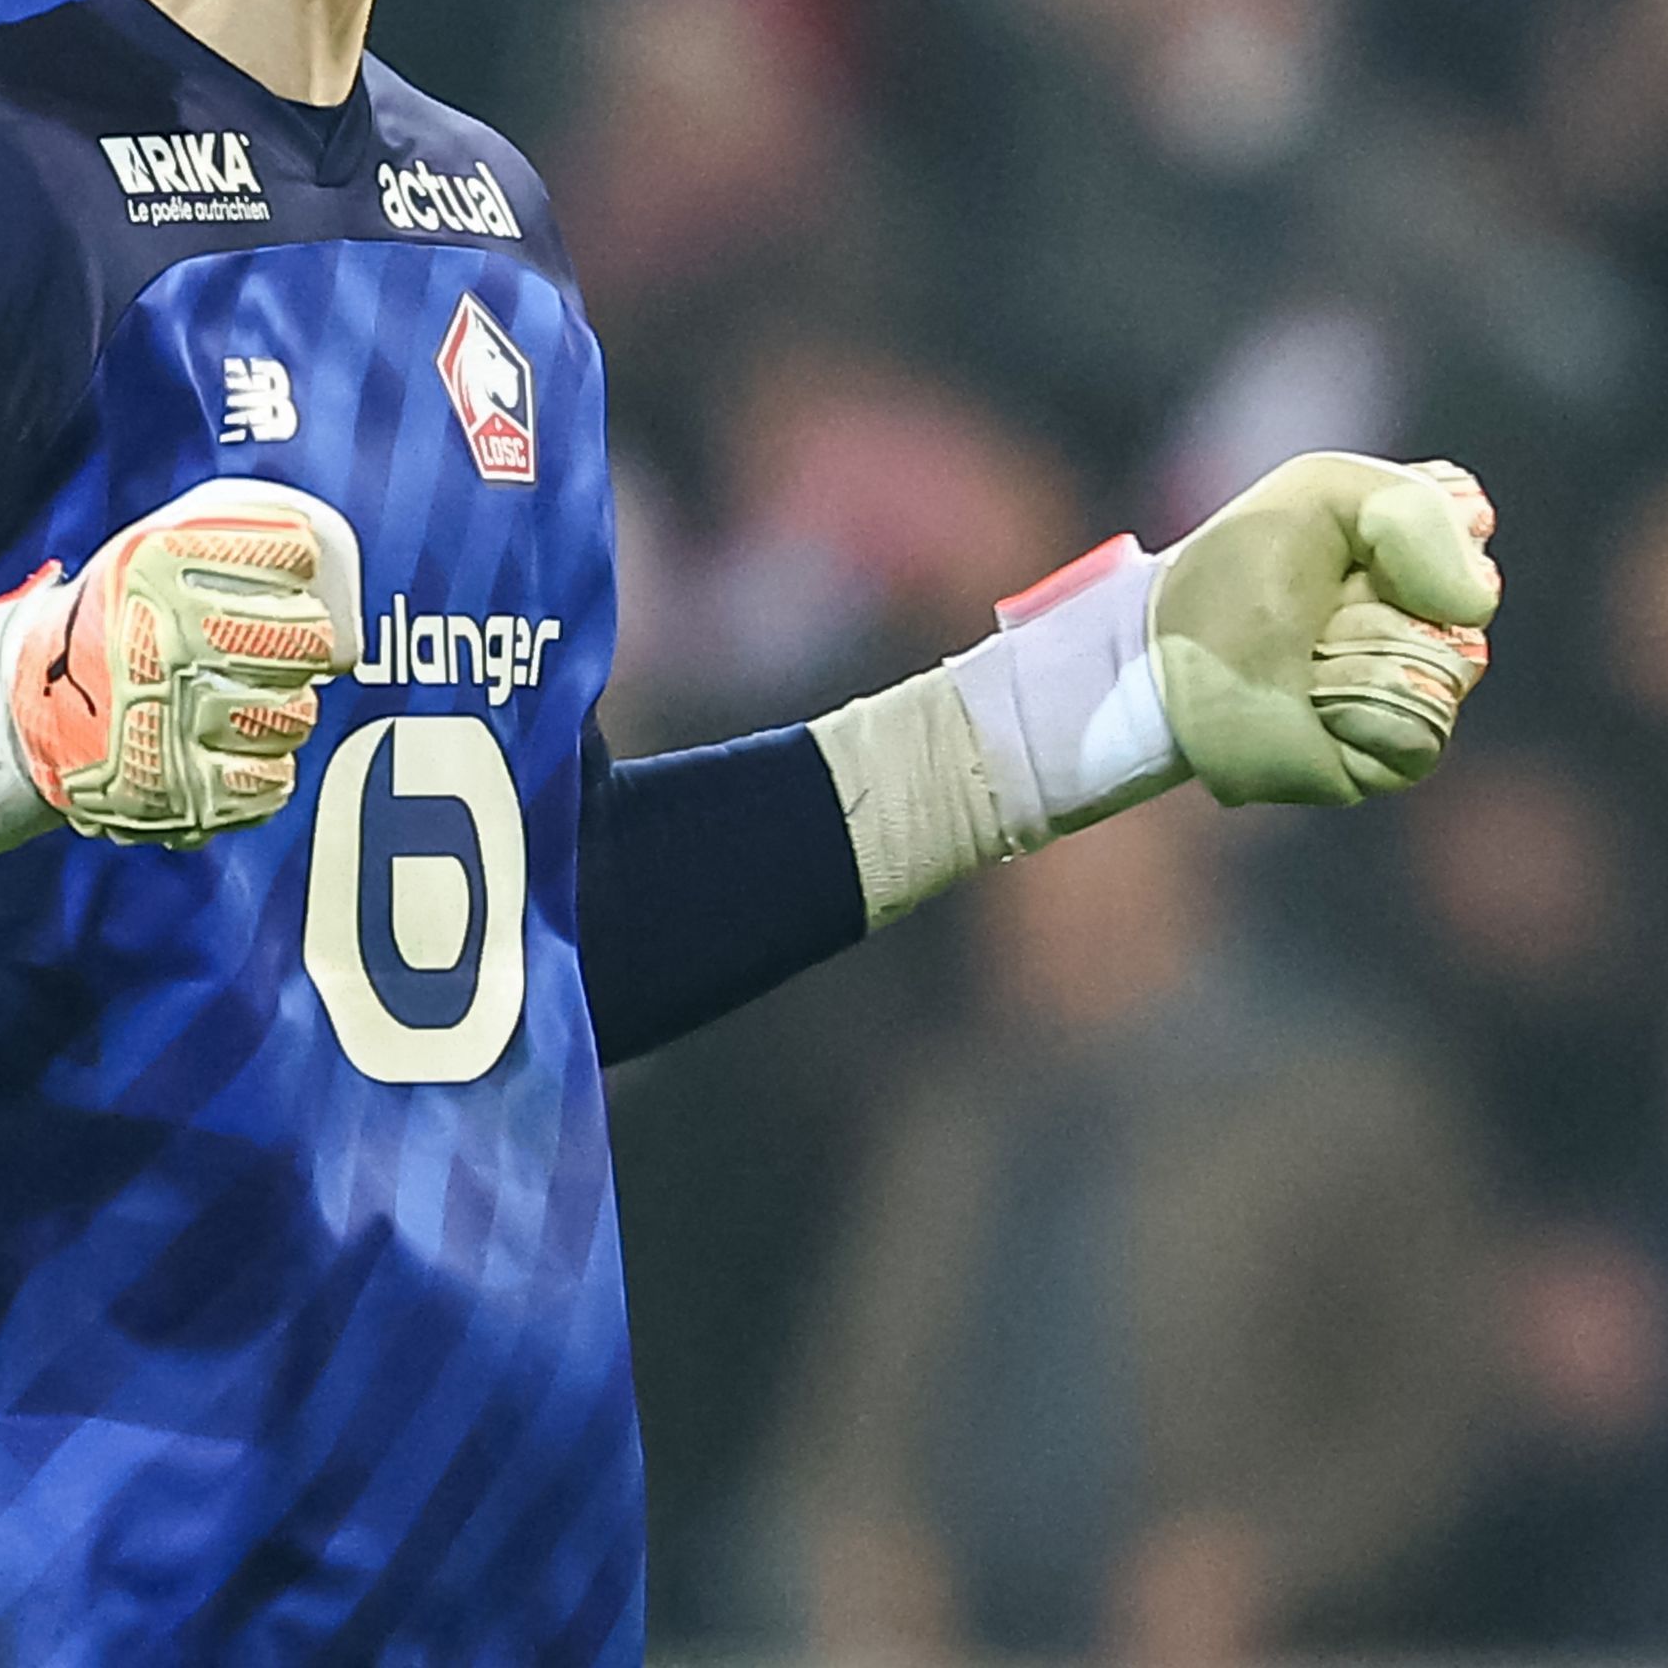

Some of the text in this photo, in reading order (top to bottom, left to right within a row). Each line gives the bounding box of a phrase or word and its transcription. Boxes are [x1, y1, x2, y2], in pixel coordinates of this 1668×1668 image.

[136, 131, 262, 194] RIKA
[127, 198, 150, 223] Le
[194, 195, 272, 222] autrichien
[377, 159, 523, 240] actual
[478, 434, 527, 469] LOSC
[309, 593, 562, 707] ulanger
